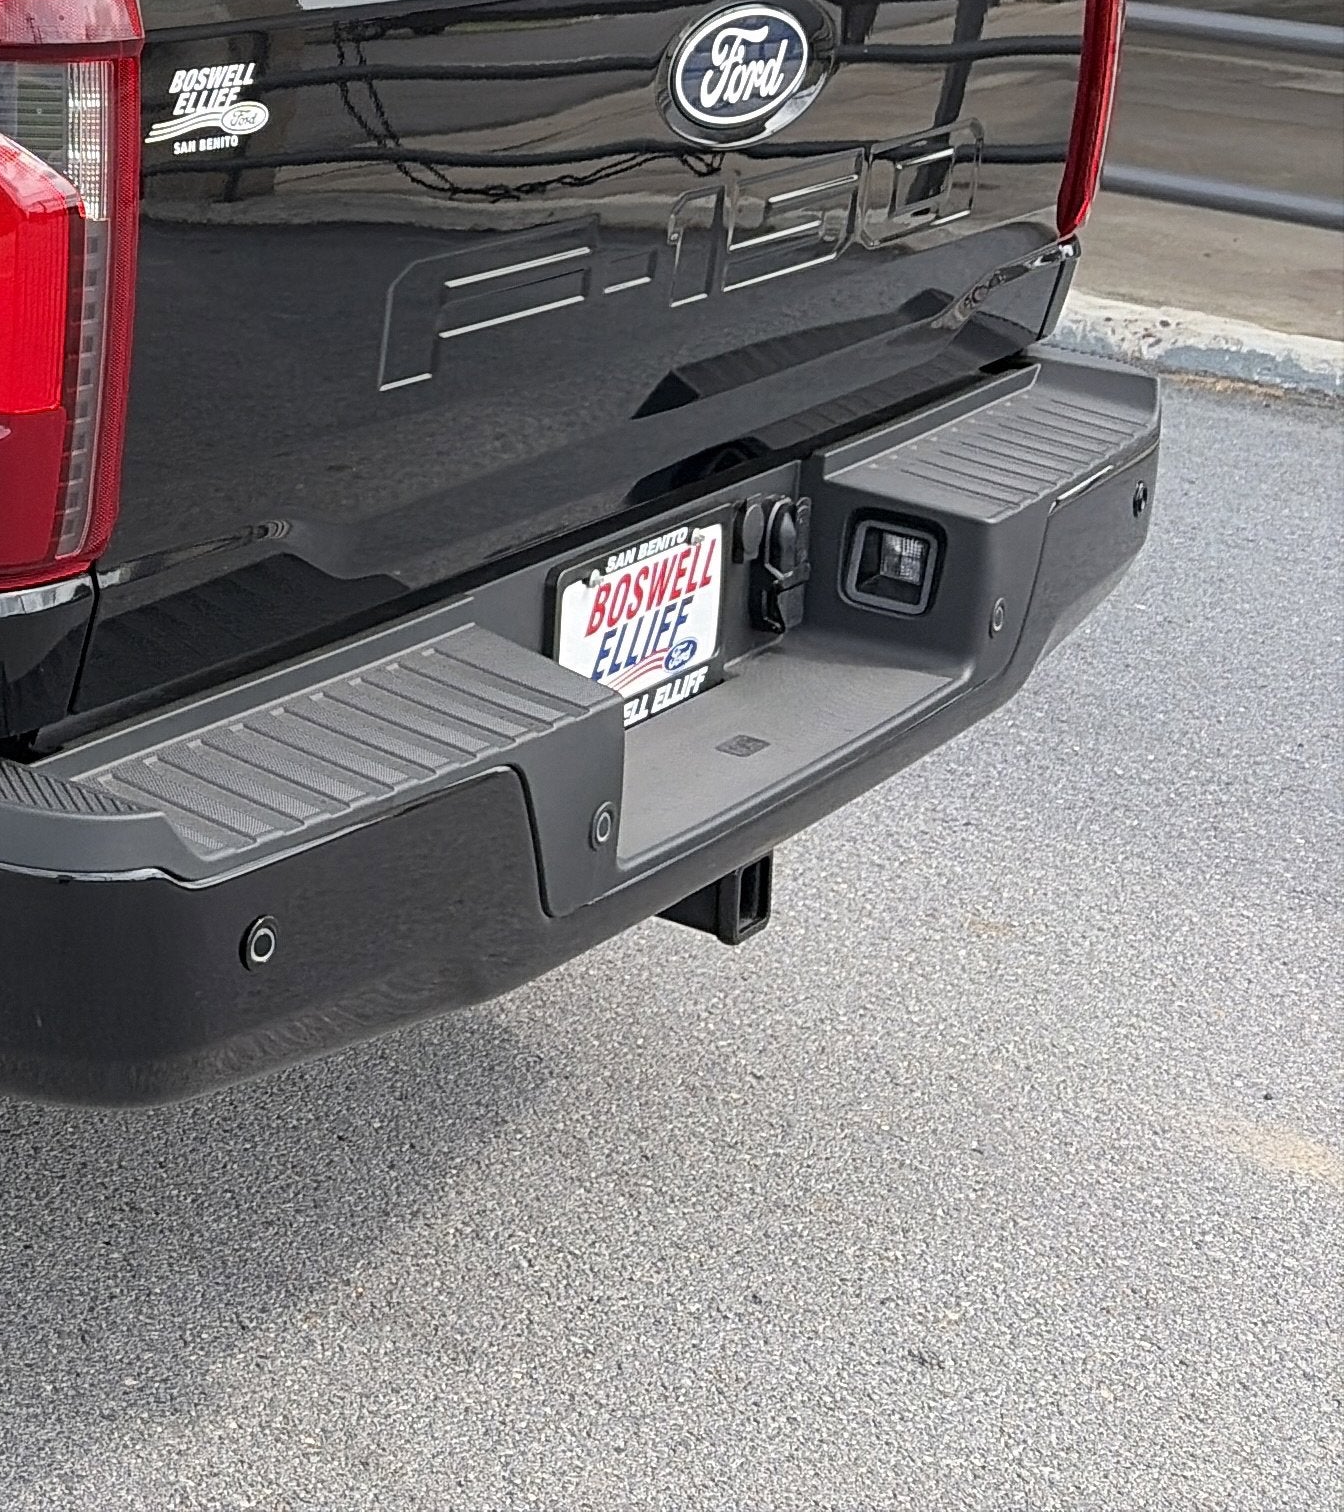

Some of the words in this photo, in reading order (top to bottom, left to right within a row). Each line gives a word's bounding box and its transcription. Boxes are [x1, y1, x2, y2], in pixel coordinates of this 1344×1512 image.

[169, 63, 256, 93] BOSWELL
[701, 24, 786, 109] Ford
[174, 140, 197, 155] SAN
[199, 135, 239, 151] BENITO
[230, 110, 258, 126] Ford
[378, 117, 985, 392] F-150
[605, 548, 636, 573] SAN
[637, 526, 689, 561] BENITO
[585, 538, 716, 637] BOSWELL
[591, 595, 694, 680] ELLIFF
[624, 694, 649, 727] ELL
[651, 666, 709, 714] ELLIFF
